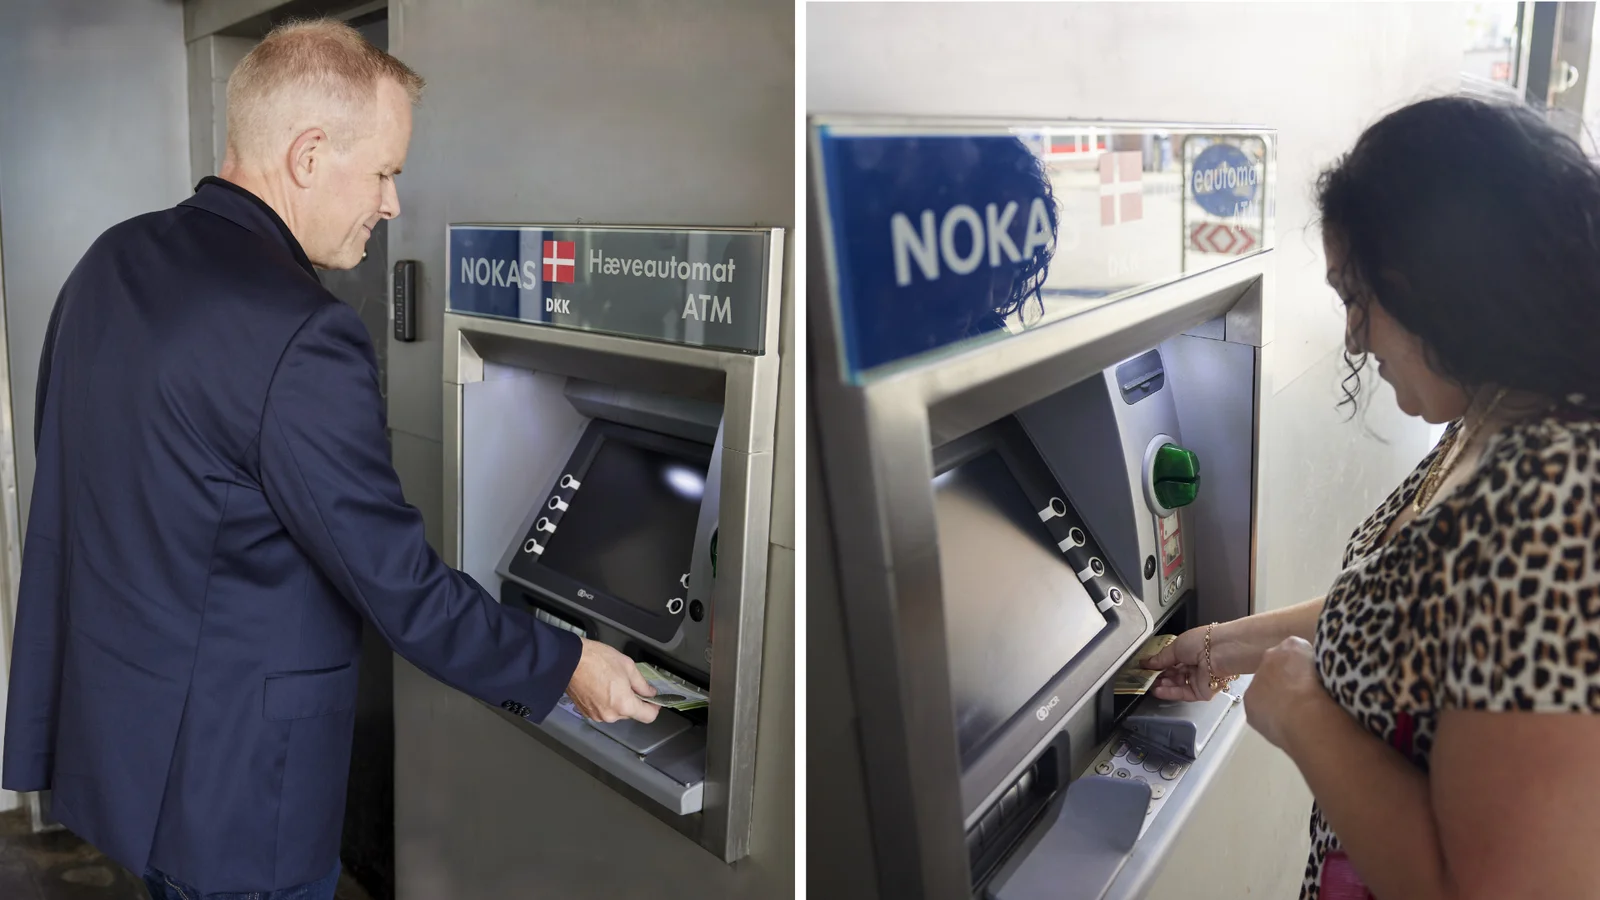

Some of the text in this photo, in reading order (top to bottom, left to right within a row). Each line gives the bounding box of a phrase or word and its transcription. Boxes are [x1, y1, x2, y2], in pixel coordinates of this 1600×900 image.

[890, 197, 1056, 287] NOKA
[461, 256, 537, 290] NOKAS
[589, 249, 736, 284] Hæveautomat
[545, 298, 571, 314] DKK
[681, 294, 733, 324] ATM
